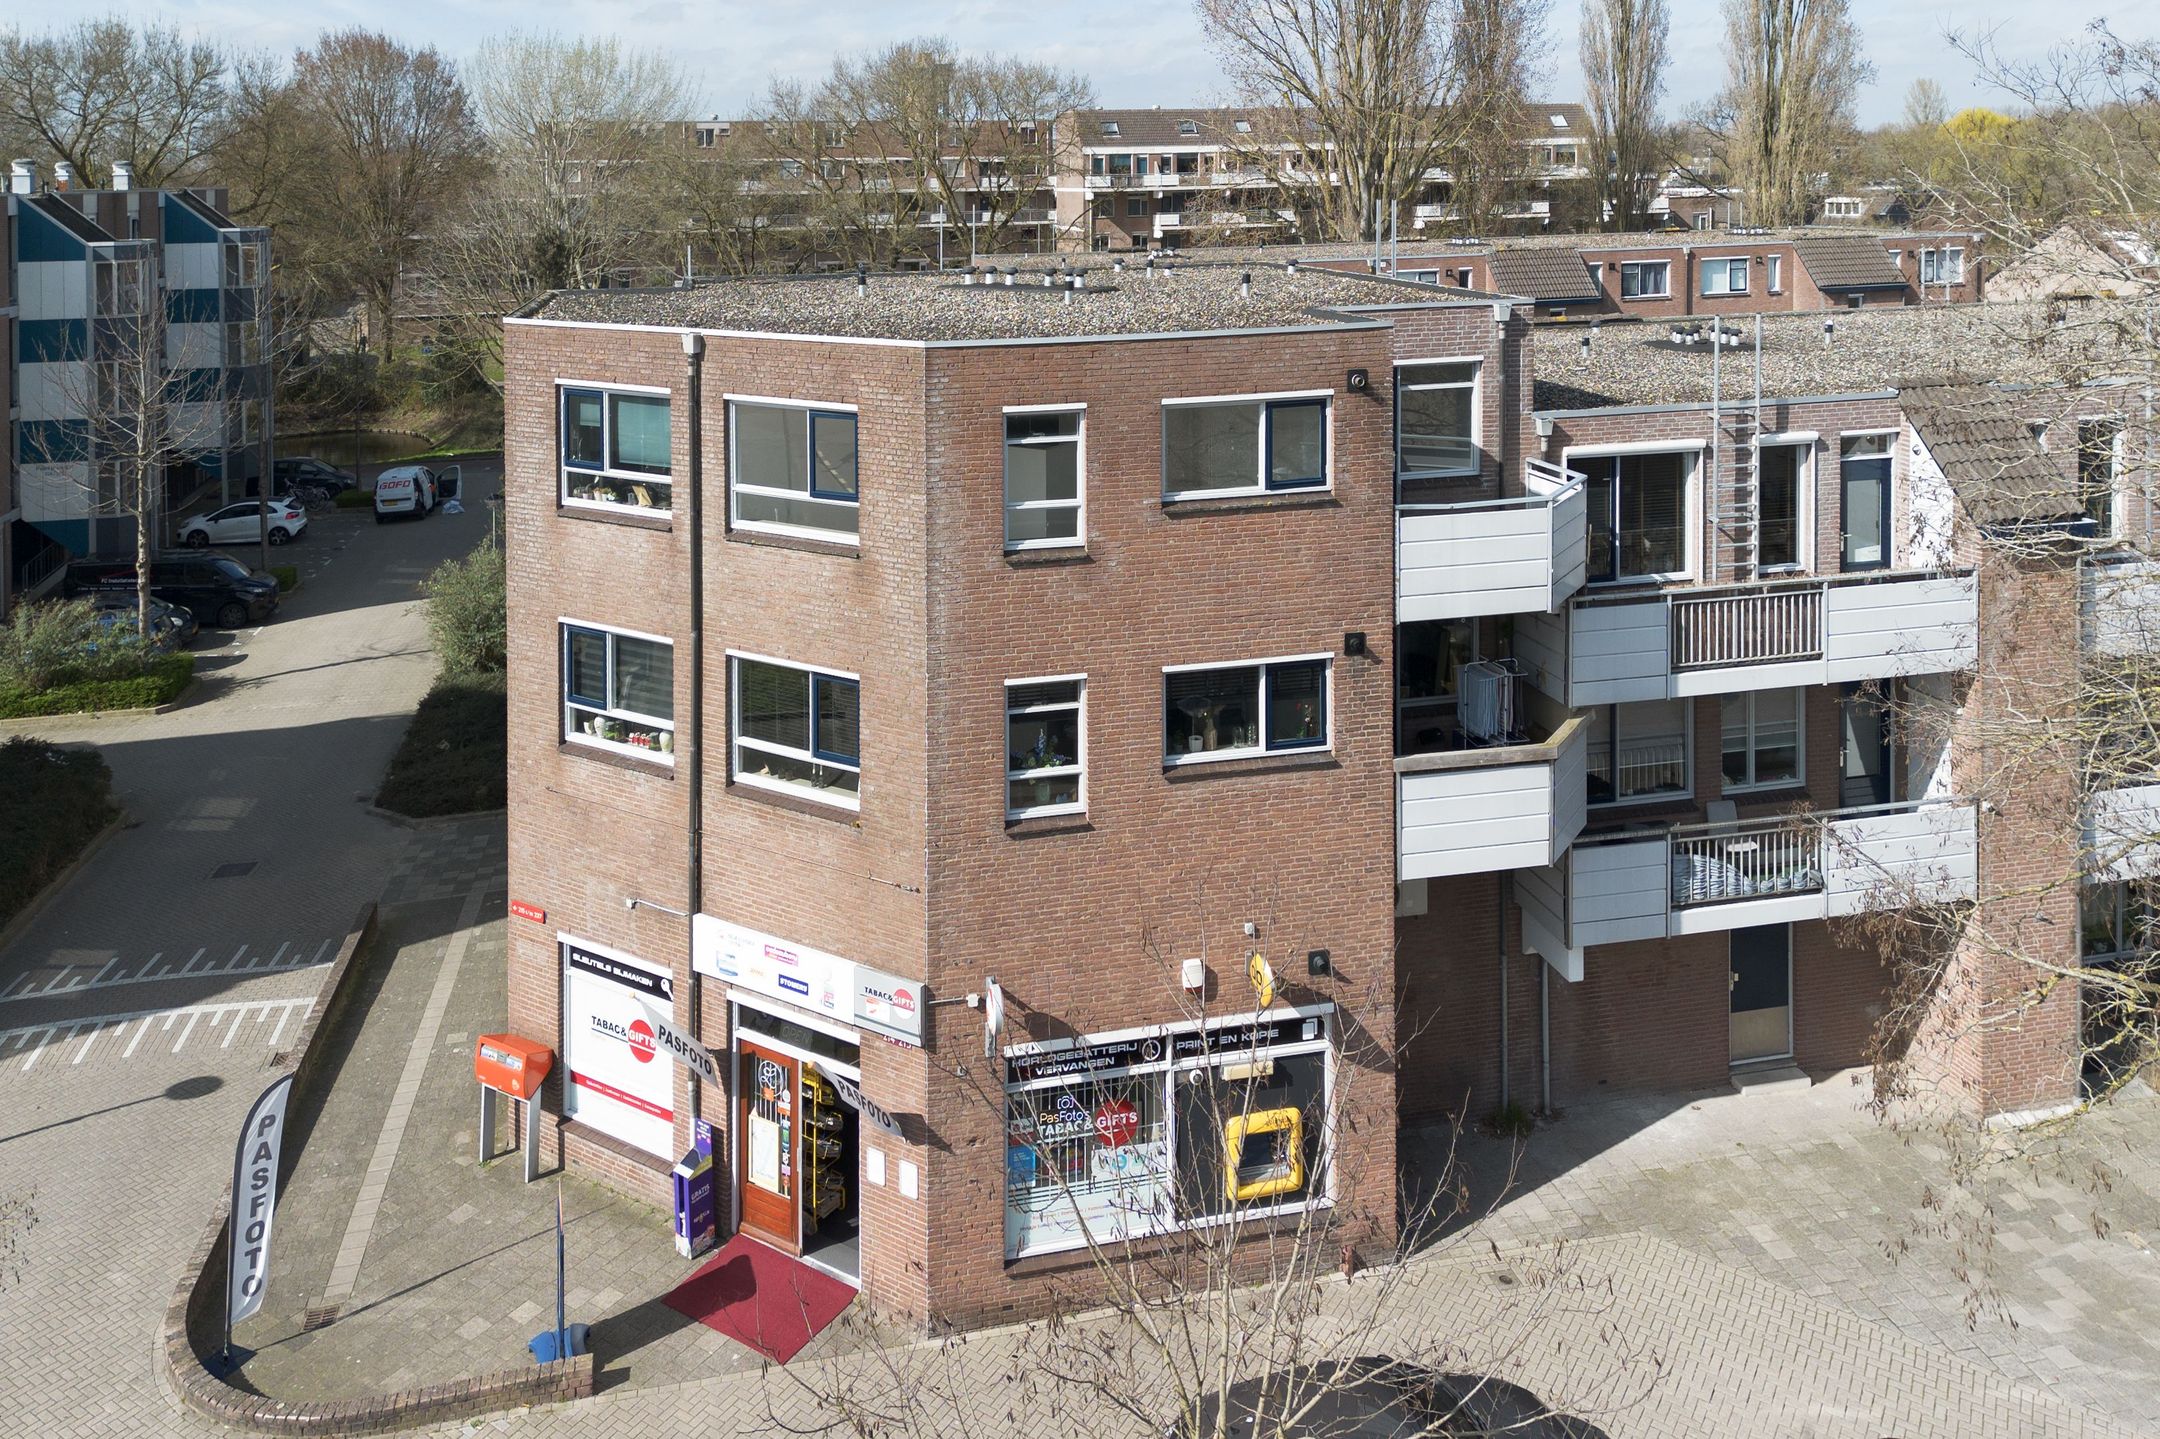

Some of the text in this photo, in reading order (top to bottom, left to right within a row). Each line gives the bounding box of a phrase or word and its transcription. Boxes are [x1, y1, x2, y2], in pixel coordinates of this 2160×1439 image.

[380, 480, 411, 490] GOFO
[572, 953, 653, 987] SLEUTELS BIJMAKEN
[892, 995, 915, 1009] GIFTS
[627, 1029, 657, 1049] GIFTS
[658, 1023, 712, 1076] PASFOTO
[1176, 1028, 1280, 1051] PRINT EN KOPIE
[1036, 1056, 1115, 1077] VERVANGEN
[836, 1079, 892, 1129] PASFOTO
[1096, 1111, 1138, 1128] GIFTS
[241, 1113, 277, 1298] PASFOTO
